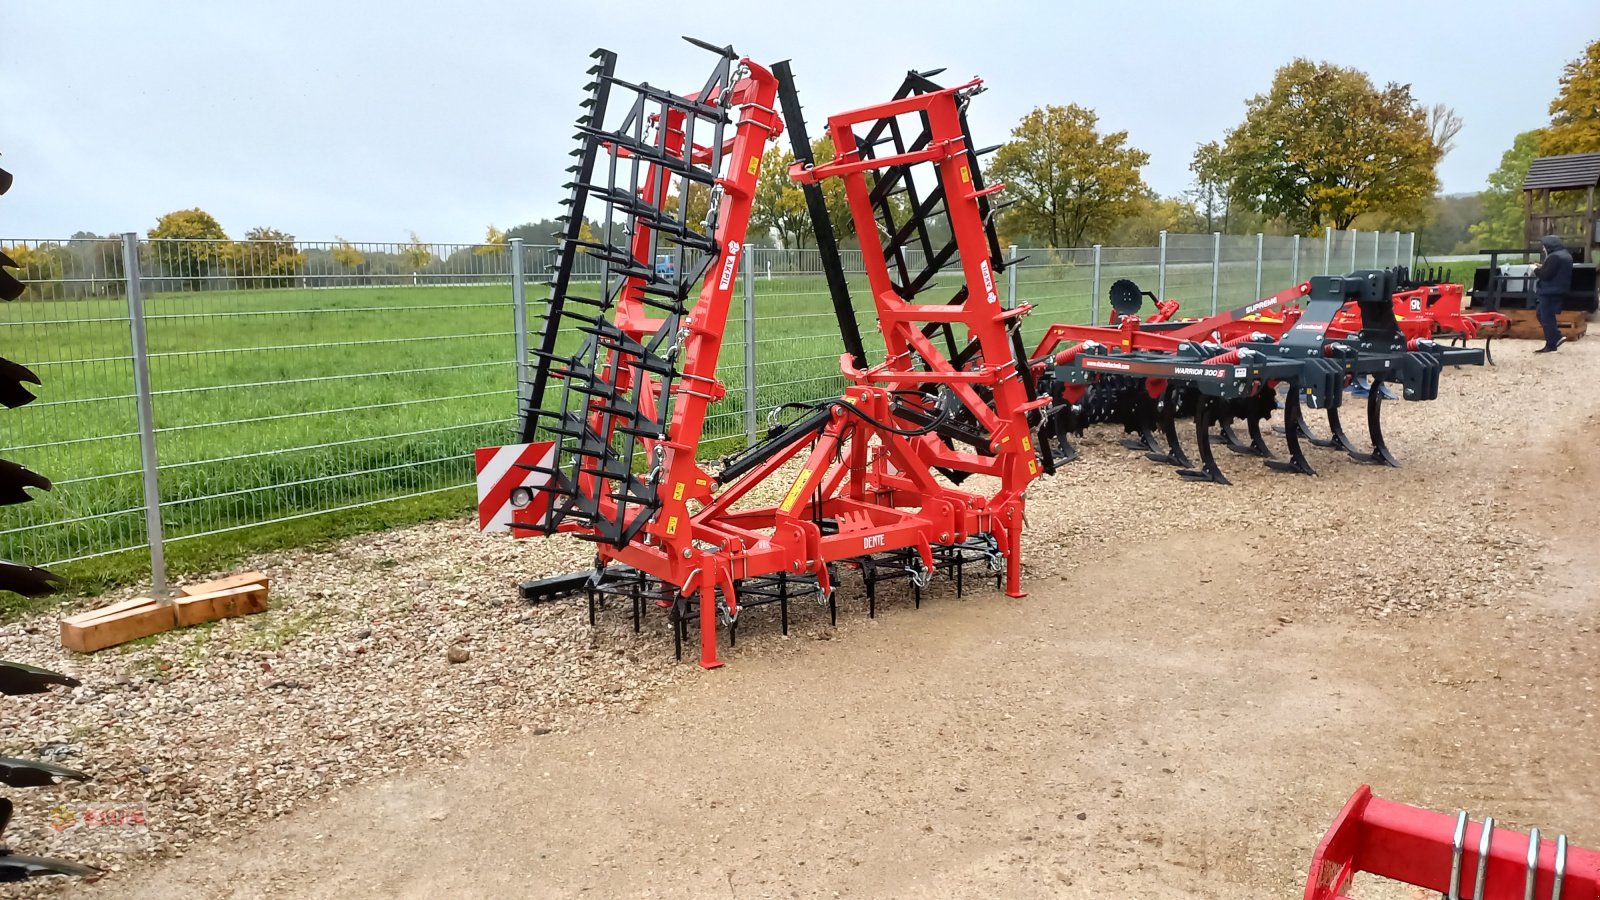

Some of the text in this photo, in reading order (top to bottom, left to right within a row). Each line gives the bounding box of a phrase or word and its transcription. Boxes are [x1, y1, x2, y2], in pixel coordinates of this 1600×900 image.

[721, 258, 733, 286] AKPIL
[1245, 296, 1278, 314] SUPREME
[1175, 366, 1204, 376] WARRIOR
[863, 534, 885, 550] DENTE
